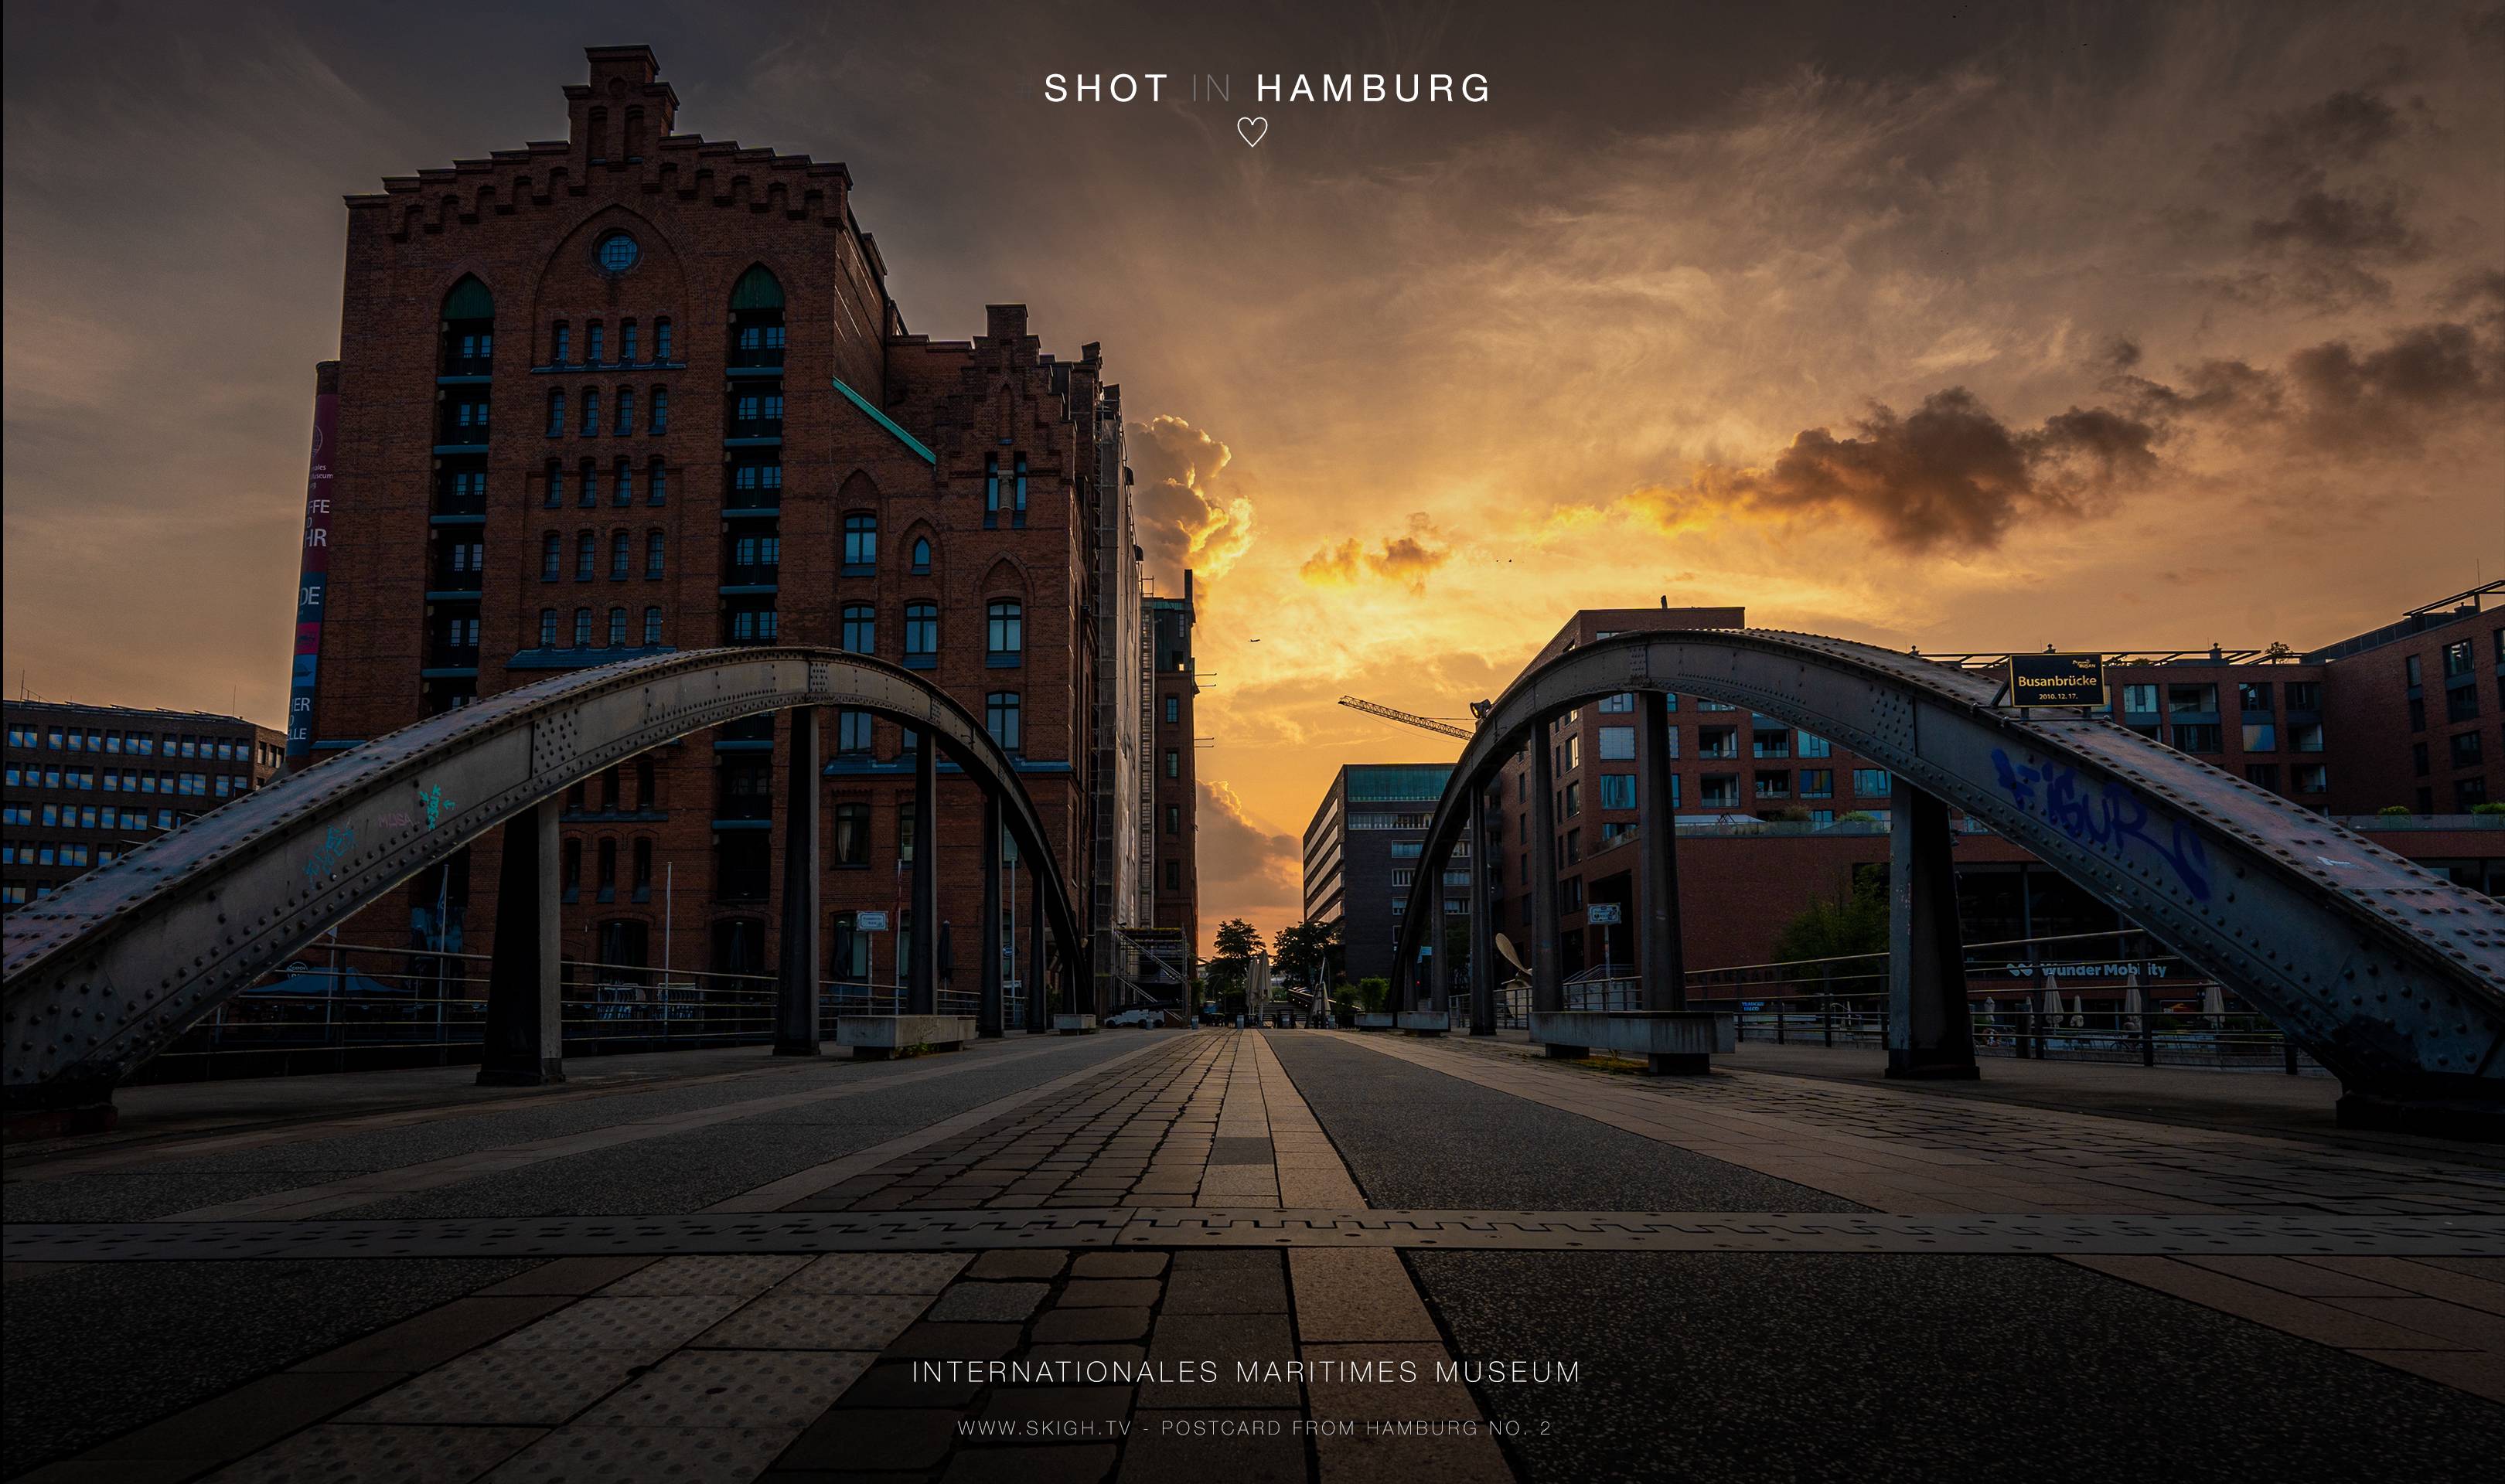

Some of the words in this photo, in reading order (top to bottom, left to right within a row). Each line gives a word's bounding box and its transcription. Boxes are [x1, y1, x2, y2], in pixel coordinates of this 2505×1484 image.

[2018, 676, 2097, 687] Busanbrücke
[2040, 962, 2101, 977] Wunder
[2103, 962, 2167, 978] Mobiity
